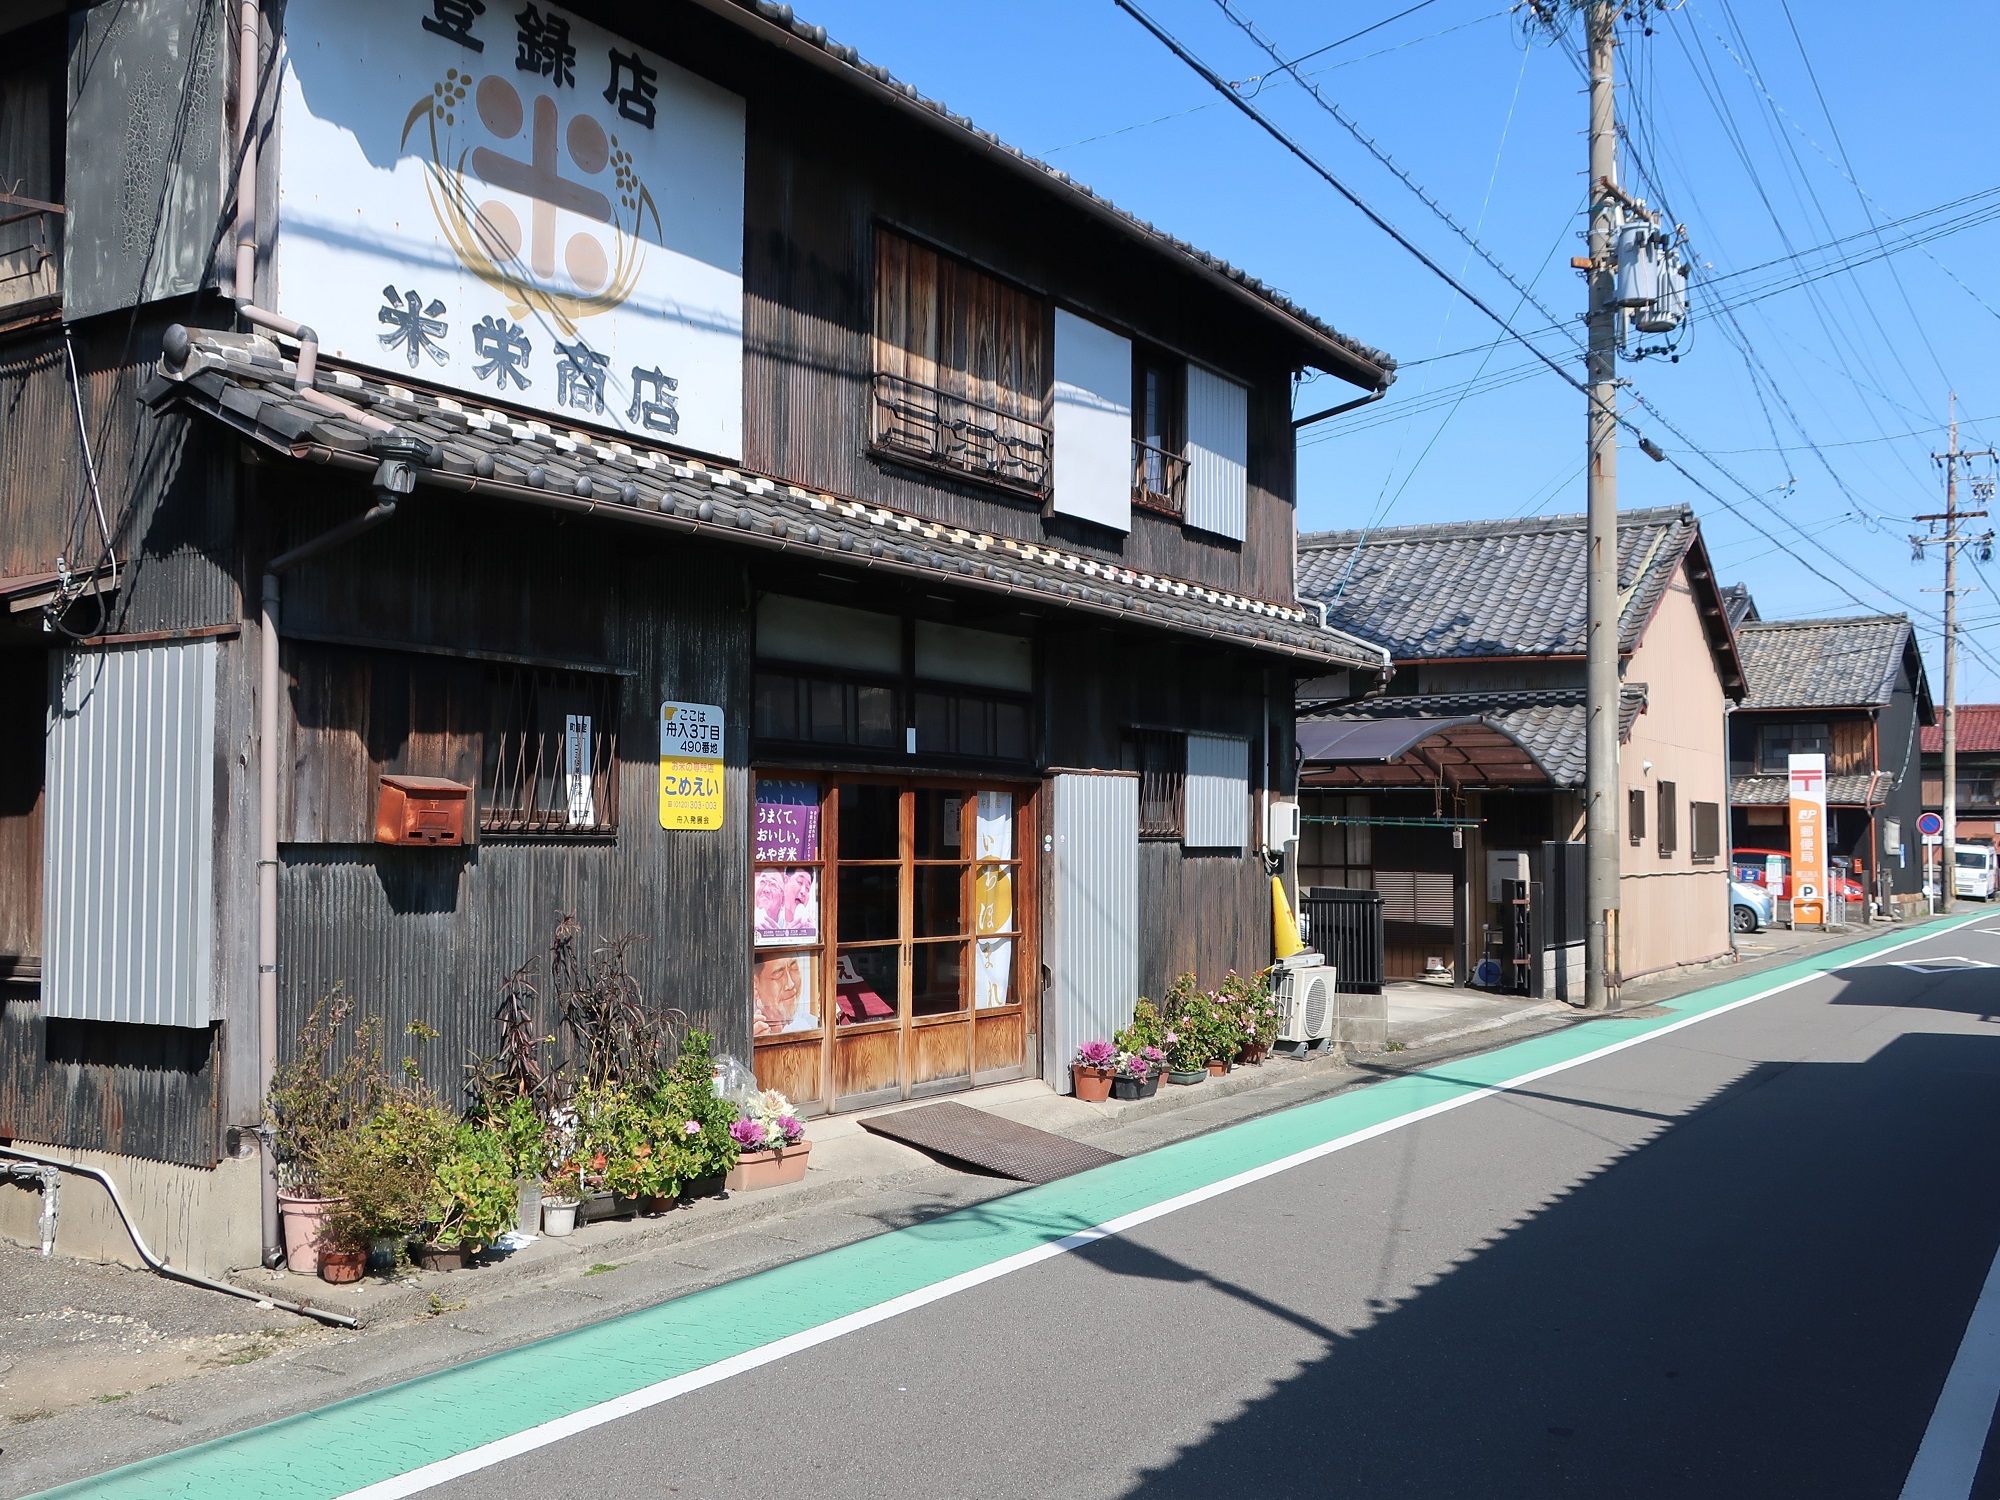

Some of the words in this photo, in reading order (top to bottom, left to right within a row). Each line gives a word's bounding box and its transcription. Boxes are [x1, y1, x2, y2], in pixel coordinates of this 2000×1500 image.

[375, 284, 680, 436] 米栄商店
[680, 709, 706, 722] ここは
[666, 722, 720, 741] 舟入3丁目
[680, 741, 718, 754] 490番地
[671, 761, 715, 773] お米の専門店
[665, 776, 719, 797] こめえい
[676, 815, 710, 825] 舟入発展会
[759, 807, 797, 825] うまくて、
[756, 828, 800, 844] おいしい。
[1799, 825, 1814, 863] 郵便局
[755, 846, 797, 861] みやぎ米
[1803, 886, 1813, 897] P
